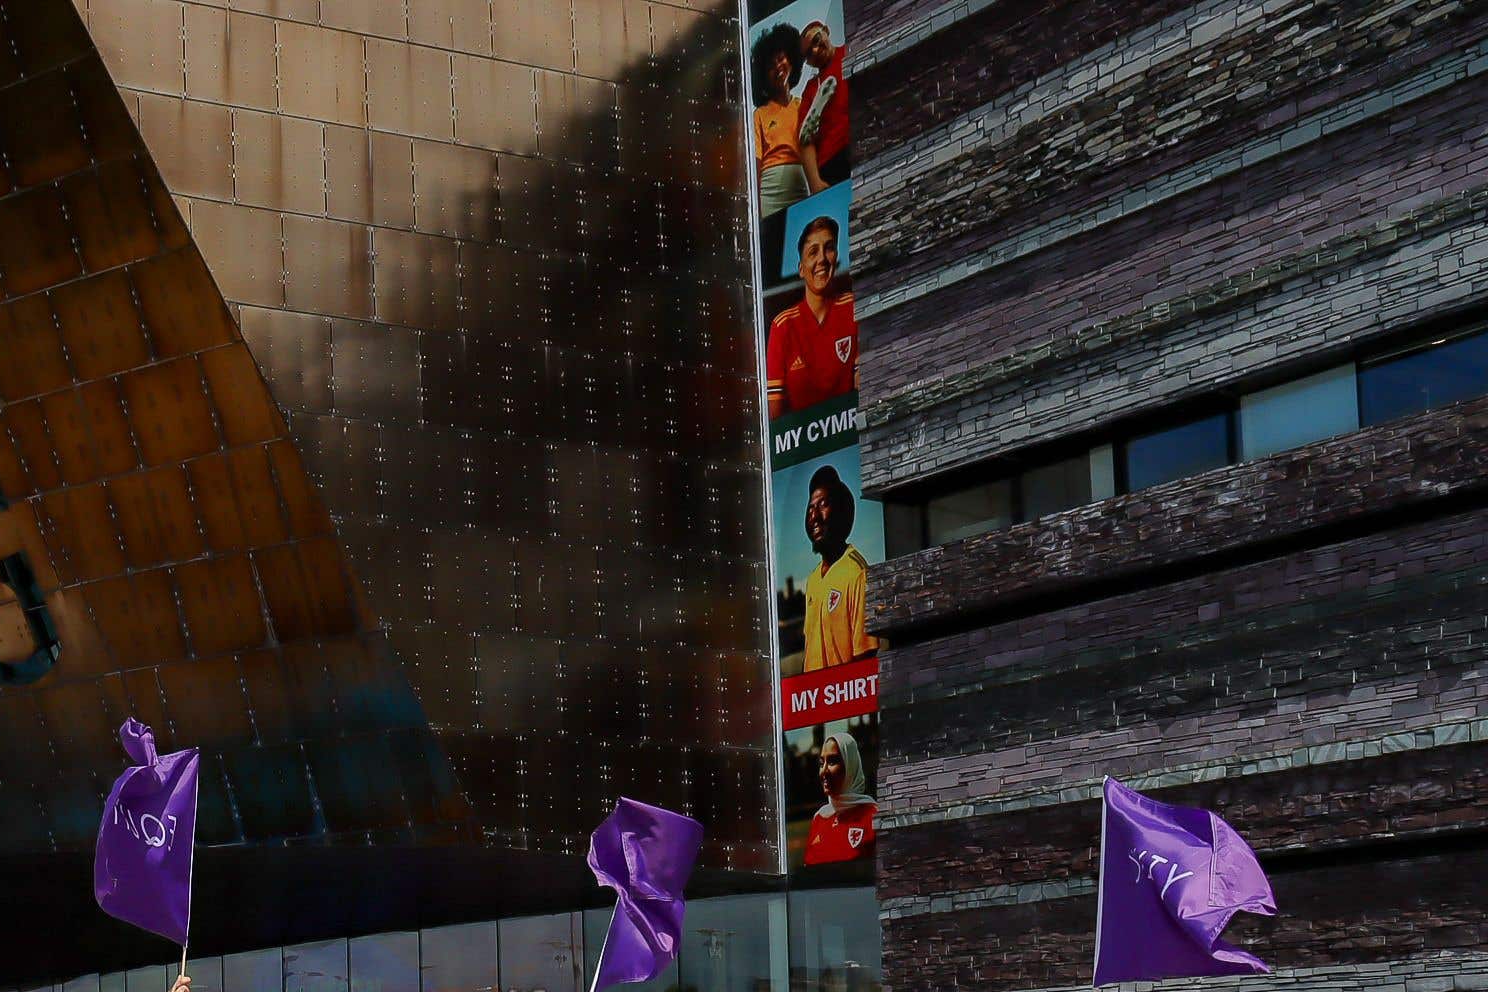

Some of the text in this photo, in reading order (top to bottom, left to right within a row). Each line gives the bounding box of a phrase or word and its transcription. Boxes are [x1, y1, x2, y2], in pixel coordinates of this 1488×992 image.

[775, 406, 858, 455] MY CYMR
[791, 674, 878, 714] MY SHIRT
